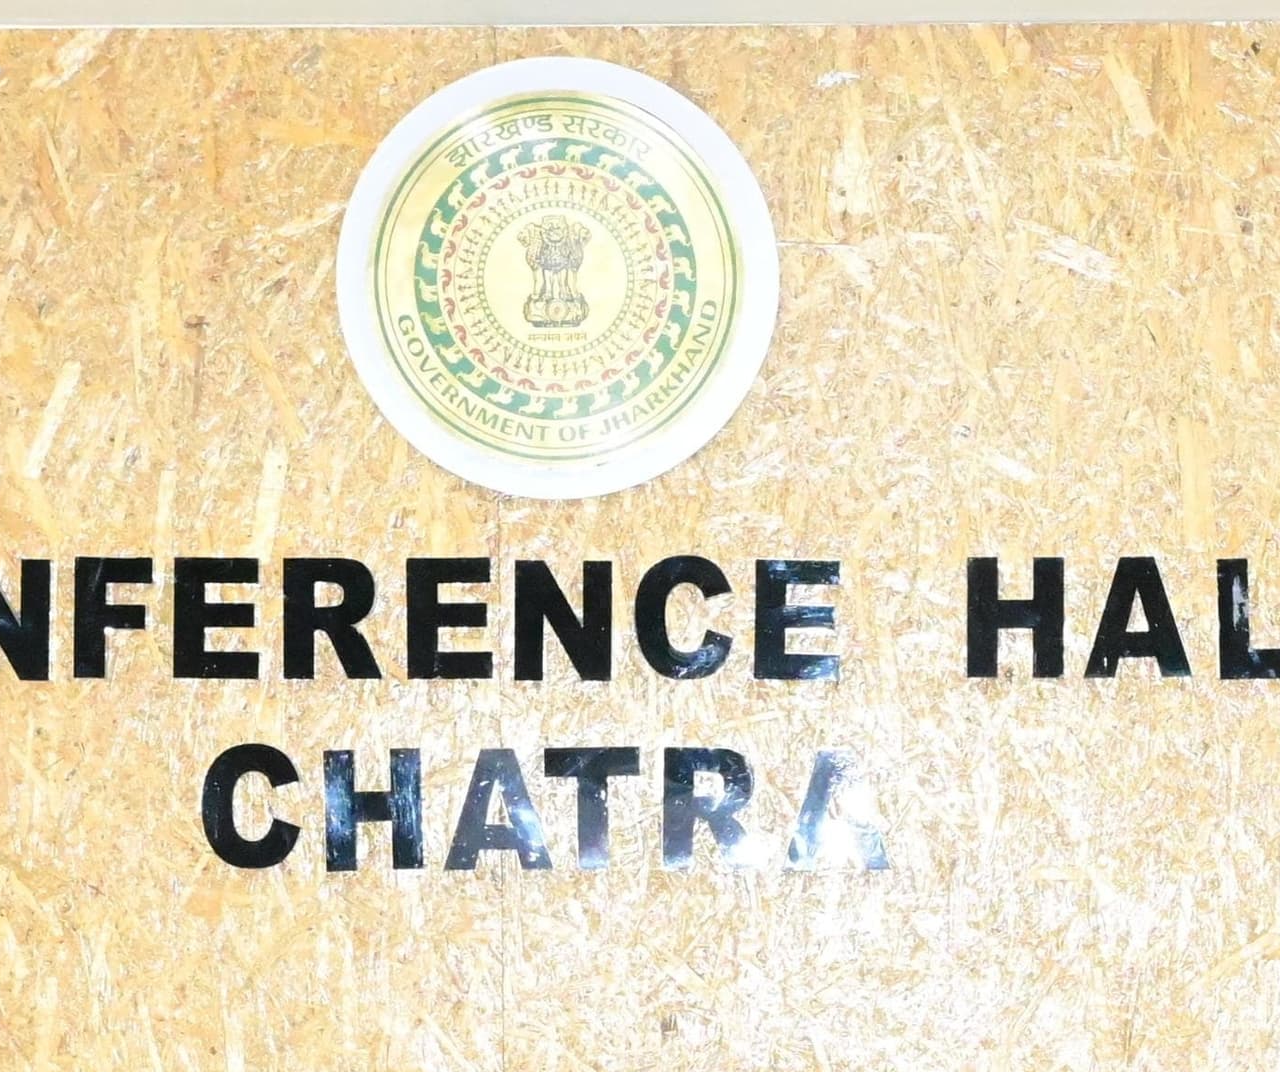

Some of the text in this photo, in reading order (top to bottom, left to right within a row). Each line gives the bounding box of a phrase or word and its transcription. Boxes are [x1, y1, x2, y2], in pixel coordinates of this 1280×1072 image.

[444, 113, 653, 168] झारखण्ड सरकार
[397, 299, 718, 442] GOVERNMENT OF JHARKHAND
[201, 743, 888, 872] CHATRA
